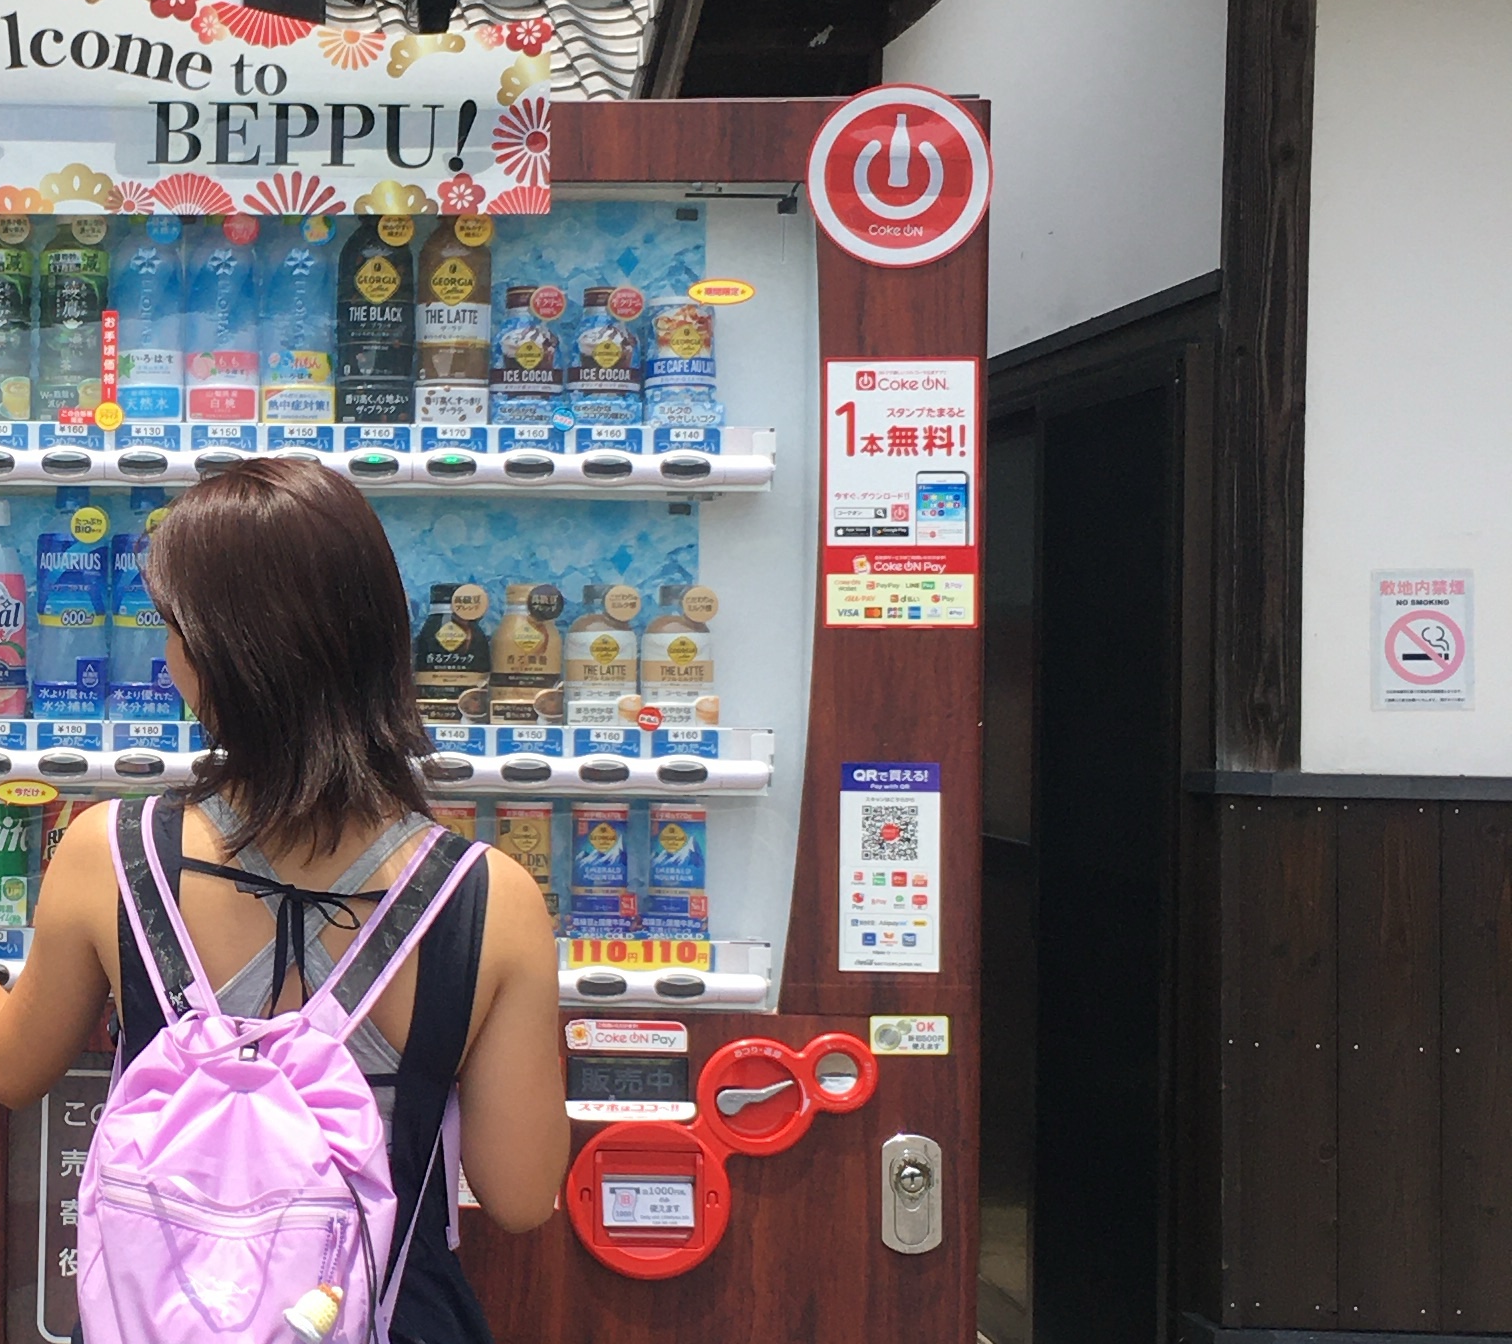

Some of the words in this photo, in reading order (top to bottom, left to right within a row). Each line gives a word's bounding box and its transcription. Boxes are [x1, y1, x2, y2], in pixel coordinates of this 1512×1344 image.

[230, 53, 288, 97] to
[146, 98, 479, 171] BEPPU!
[868, 224, 901, 237] Coke
[358, 276, 397, 285] GEORGIA
[432, 277, 474, 287] GEORGIA
[349, 306, 367, 321] THE
[370, 306, 403, 322] BLACK
[425, 309, 443, 324] THE
[447, 310, 478, 325] LATTE
[654, 363, 666, 374] ICE
[667, 362, 689, 374] CAFE
[503, 370, 519, 382] ICE
[522, 370, 553, 382] COCOA
[579, 369, 595, 381] ICE
[598, 369, 631, 381] COCOA
[878, 377, 919, 391] Coke
[922, 375, 948, 391] ON
[126, 398, 169, 411] 天然水
[659, 406, 692, 415] ミルクの
[886, 407, 966, 418] スタンプたまると
[667, 414, 716, 423] やさしいコク
[58, 425, 85, 434] ¥160
[134, 427, 162, 436] ¥130
[211, 427, 238, 437] ¥150
[287, 427, 314, 437] ¥150
[363, 428, 391, 437] ¥160
[440, 428, 467, 437] ¥170
[517, 429, 545, 438] ¥160
[596, 429, 622, 438] ¥160
[674, 431, 700, 440] ¥140
[39, 552, 101, 570] AQUARIUS
[874, 562, 903, 572] Coke
[924, 562, 947, 574] Pay
[1379, 579, 1466, 596] 敷地内禁煙
[837, 608, 859, 617] VISA
[426, 653, 474, 663] 香るブラック
[583, 664, 598, 675] THE
[600, 665, 626, 676] LATTE
[660, 665, 676, 676] THE
[677, 666, 704, 677] LATTE
[39, 689, 98, 700] 水より優れた
[114, 689, 174, 701] 水より優れた
[42, 701, 95, 712] 水分補給
[118, 702, 170, 713] 水分補給
[57, 725, 83, 733] ¥180
[133, 726, 159, 735] ¥180
[440, 730, 465, 738] ¥140
[517, 731, 543, 739] ¥150
[594, 731, 620, 740] ¥160
[672, 731, 698, 740] ¥160
[14, 787, 40, 797] 今だけ
[572, 940, 638, 963] 110円
[641, 941, 708, 963] 110円
[916, 1021, 935, 1032] OK
[595, 1032, 627, 1043] Coke
[652, 1034, 676, 1047] Pay
[582, 1066, 673, 1093] 販売中
